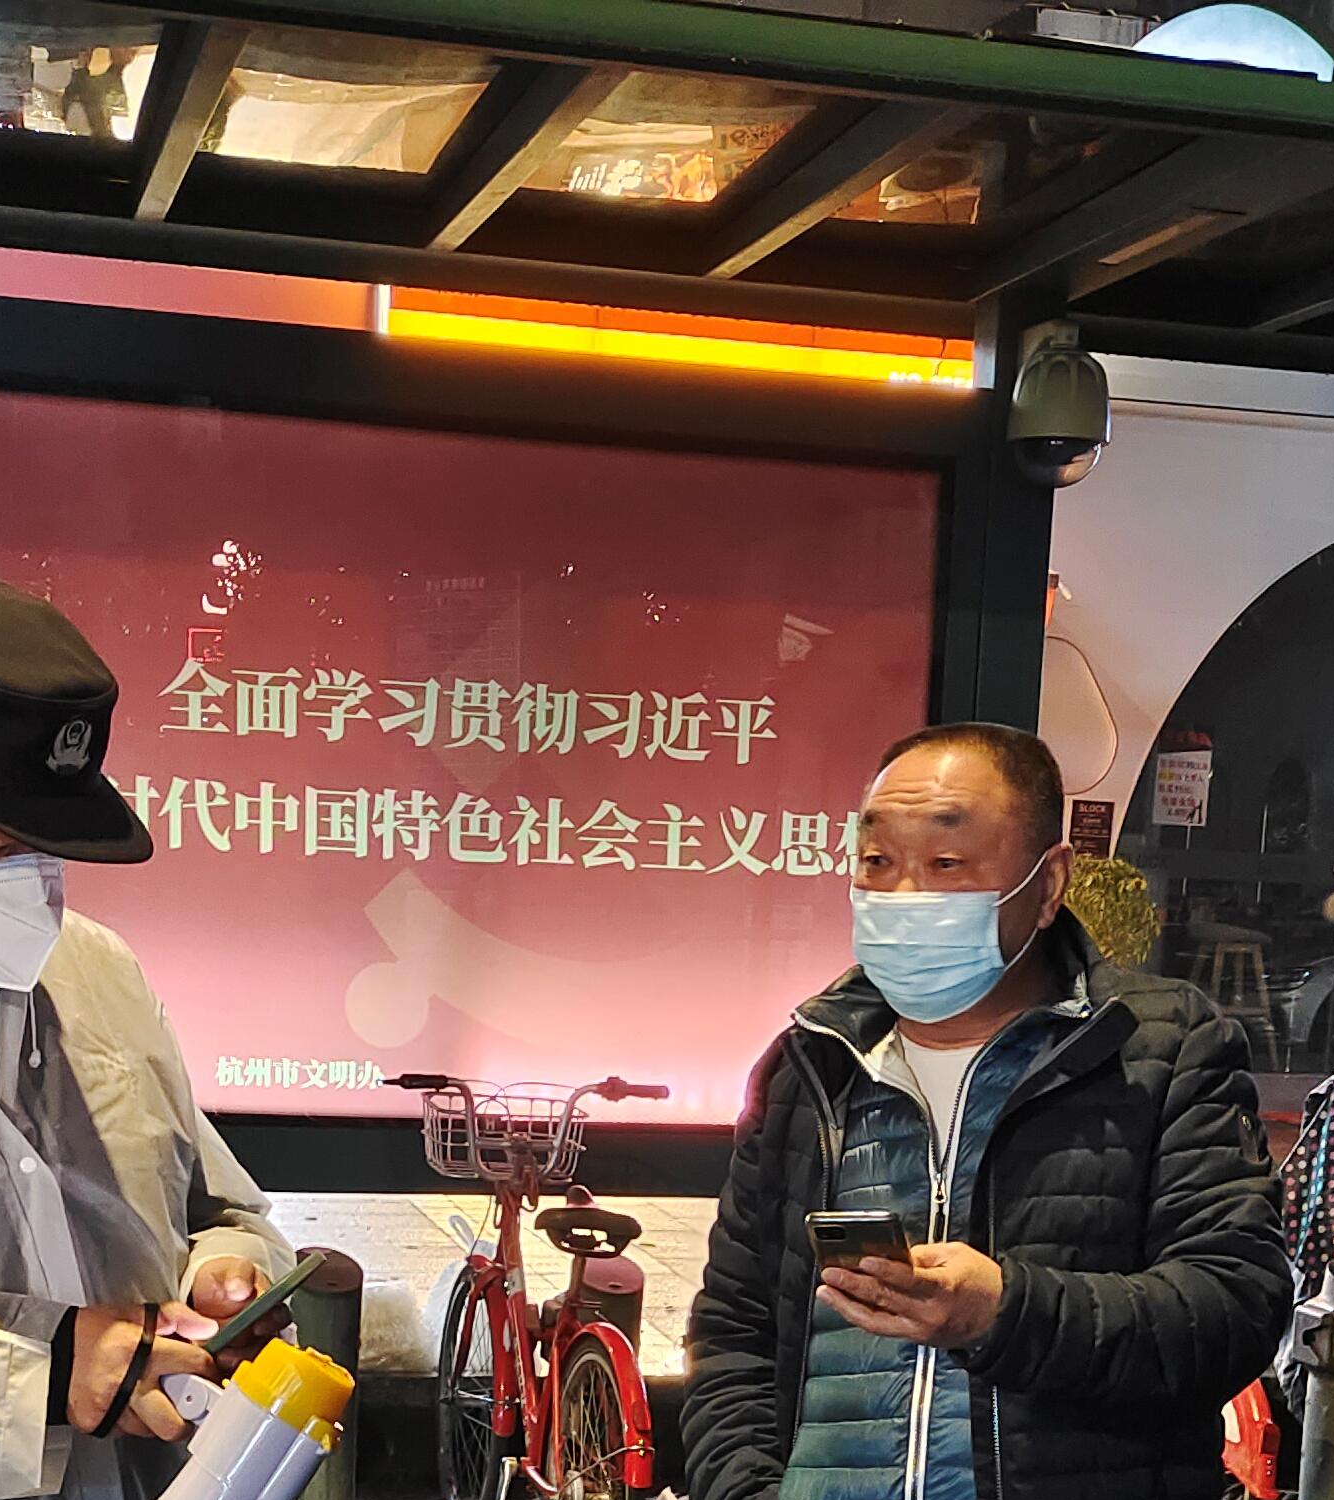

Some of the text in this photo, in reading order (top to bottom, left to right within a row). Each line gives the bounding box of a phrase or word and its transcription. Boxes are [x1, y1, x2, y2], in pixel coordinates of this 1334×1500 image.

[159, 659, 777, 765] 全面学习贯彻习近平
[215, 1055, 387, 1091] 杭州市文明办
